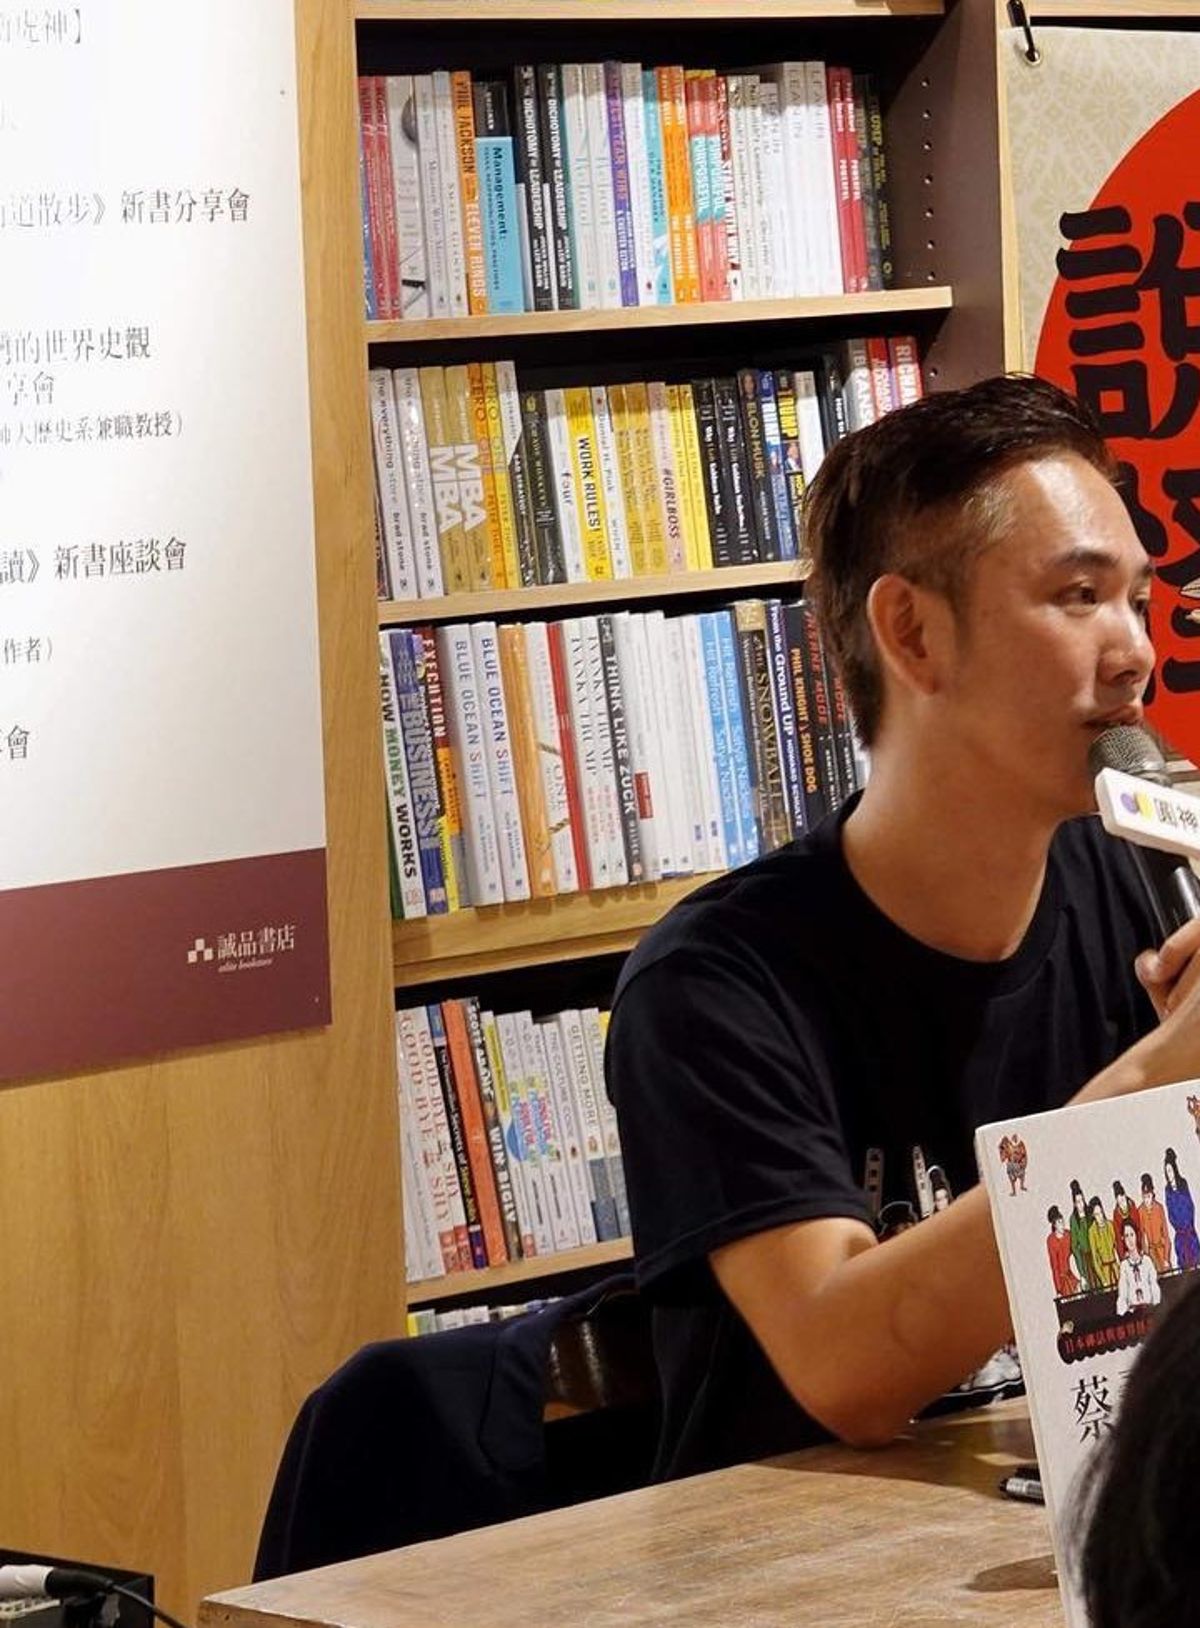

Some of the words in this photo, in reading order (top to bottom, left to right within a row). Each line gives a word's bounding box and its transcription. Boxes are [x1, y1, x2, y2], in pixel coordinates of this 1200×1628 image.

[457, 115, 477, 175] JACKSON
[522, 98, 538, 158] DICHOTOMY
[547, 99, 561, 158] DICHOTOMY
[120, 187, 252, 225] 新書分享會
[492, 146, 508, 241] Management:
[529, 168, 544, 229] LEADERSHIP
[552, 168, 567, 230] LEADERSHIP
[472, 377, 487, 422] ZERO
[778, 388, 798, 438] TRUMP
[854, 353, 873, 427] BRANS
[379, 399, 394, 469] everything
[746, 401, 760, 438] ELON
[760, 397, 781, 446] TRUMP
[579, 437, 597, 480] WORK
[752, 440, 765, 479] MUSK
[429, 445, 463, 535] MBA
[454, 444, 487, 532] MBA
[561, 472, 573, 507] four
[584, 482, 601, 533] RULES!
[663, 468, 680, 539] #GIRLBOSS
[392, 512, 405, 537] brad
[420, 512, 432, 537] brad
[55, 536, 187, 580] 新書座談會
[396, 540, 406, 571] stone
[424, 540, 434, 571] stone
[769, 606, 783, 634] From
[455, 640, 471, 681] BLUE
[481, 637, 496, 680] BLUE
[774, 653, 792, 713] Ground
[790, 647, 803, 676] PHIL
[804, 610, 820, 674] INSANE
[815, 680, 828, 725] MODE
[422, 639, 447, 739] EXECUTION
[603, 654, 622, 713] THINK
[707, 665, 724, 717] Refresh
[723, 662, 740, 713] Refresh
[793, 677, 809, 723] KNIGHT
[460, 689, 480, 746] OCEAN
[487, 686, 507, 742] OCEAN
[612, 716, 629, 760] LIKE
[756, 671, 784, 801] SNOWBALL
[781, 714, 794, 736] UP
[385, 727, 406, 799] MONEY
[713, 729, 728, 766] Satya
[731, 728, 746, 762] Satya
[786, 739, 798, 782] HOWARD
[800, 732, 814, 765] SHOE
[401, 710, 441, 840] BUSINESS
[468, 752, 486, 800] SHIFT
[495, 748, 514, 797] SHIFT
[618, 764, 637, 815] ZUCK
[804, 766, 818, 793] DOG
[791, 784, 803, 827] SCHULTZ
[395, 803, 417, 880] WORKS
[217, 924, 296, 960] 誠品書店
[570, 1024, 589, 1086] GETTING
[583, 1087, 598, 1129] MORE
[448, 1112, 464, 1150] Secrets
[467, 1005, 483, 1041] SCOTT
[489, 1125, 505, 1165] WIN
[497, 1170, 516, 1223] BIGLY
[430, 1177, 451, 1223] SHY
[443, 1161, 461, 1200] SHY
